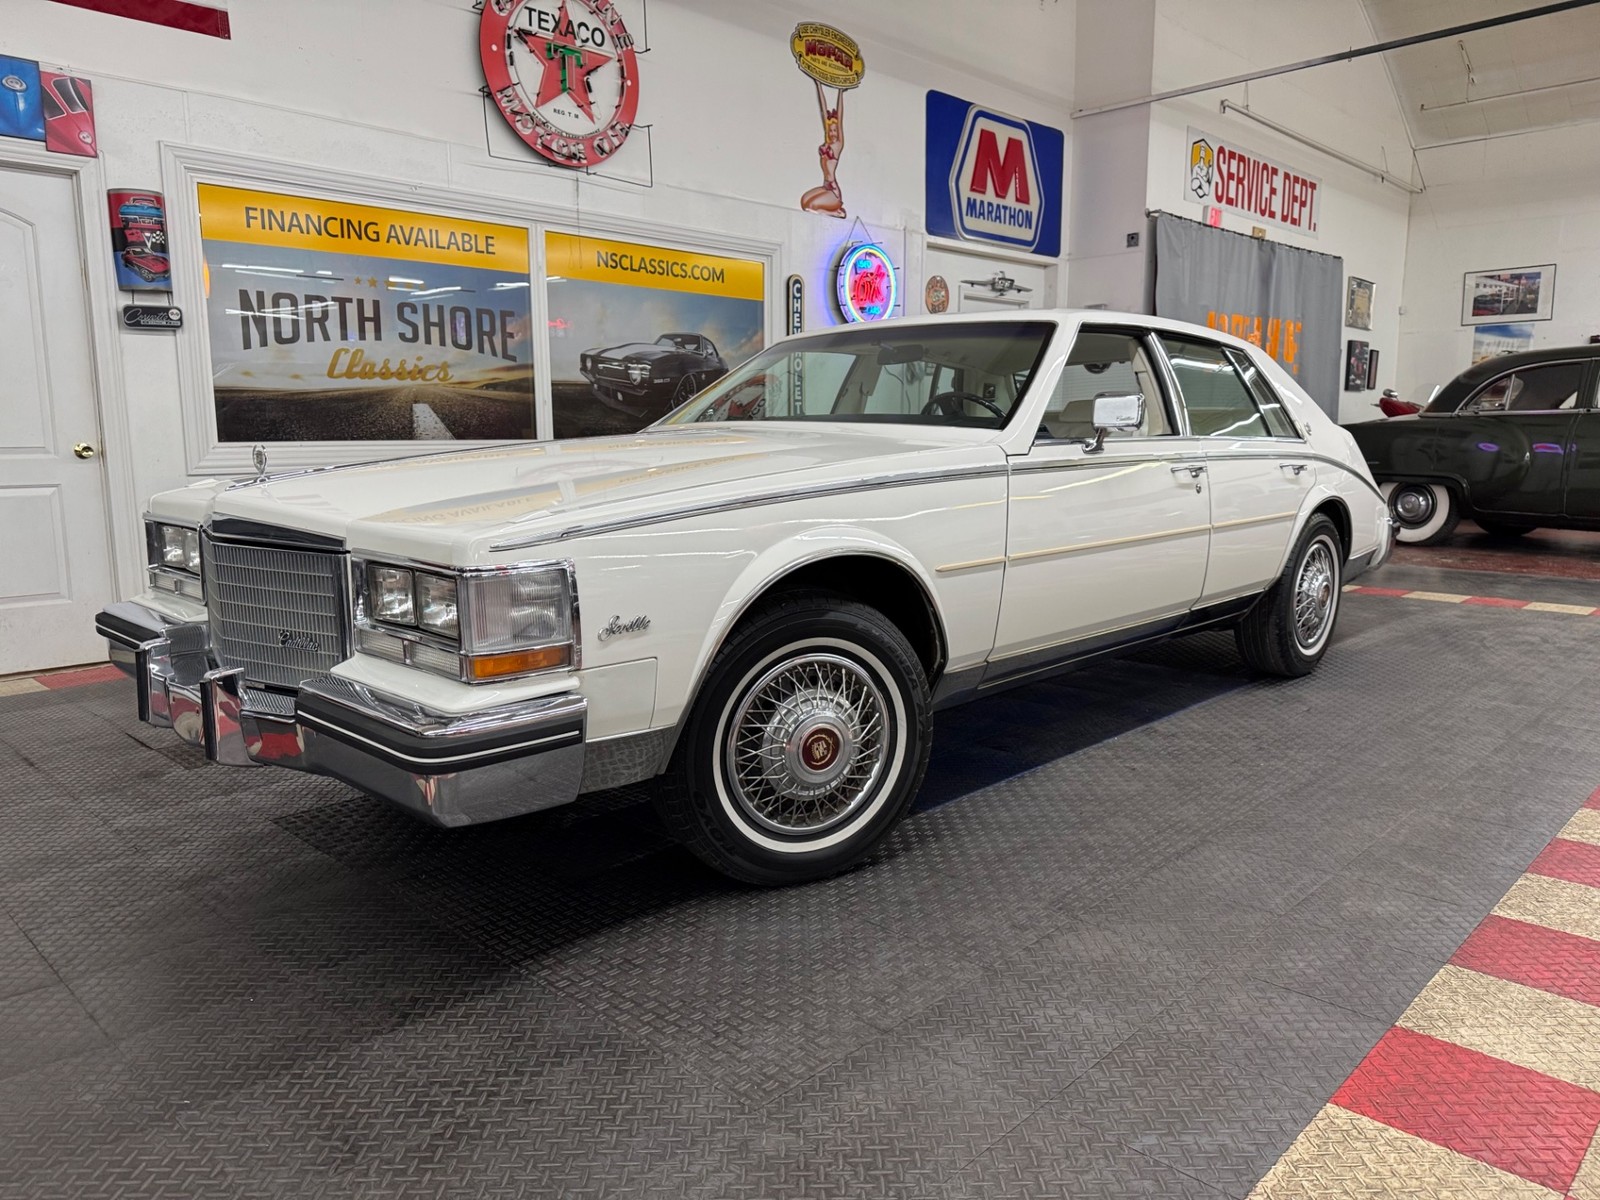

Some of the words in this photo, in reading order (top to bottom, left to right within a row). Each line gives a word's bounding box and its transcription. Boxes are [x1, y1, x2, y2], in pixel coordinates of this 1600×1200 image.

[525, 6, 606, 48] TEXACO
[805, 38, 853, 72] MOPAR
[1215, 145, 1279, 220] SERVICE
[1281, 171, 1317, 232] DEPT.
[244, 206, 380, 243] FINANCING
[385, 223, 496, 256] AVAILABLE
[965, 197, 1033, 230] MARATHON
[596, 250, 725, 284] NSCLASSICS.COM
[124, 307, 169, 324] Corvette
[238, 288, 383, 351] NORTH
[396, 301, 518, 363] SHORE
[326, 347, 455, 383] Classics
[793, 283, 802, 415] CHEOLET
[278, 630, 320, 652] Cadillac
[598, 615, 651, 641] Seville
